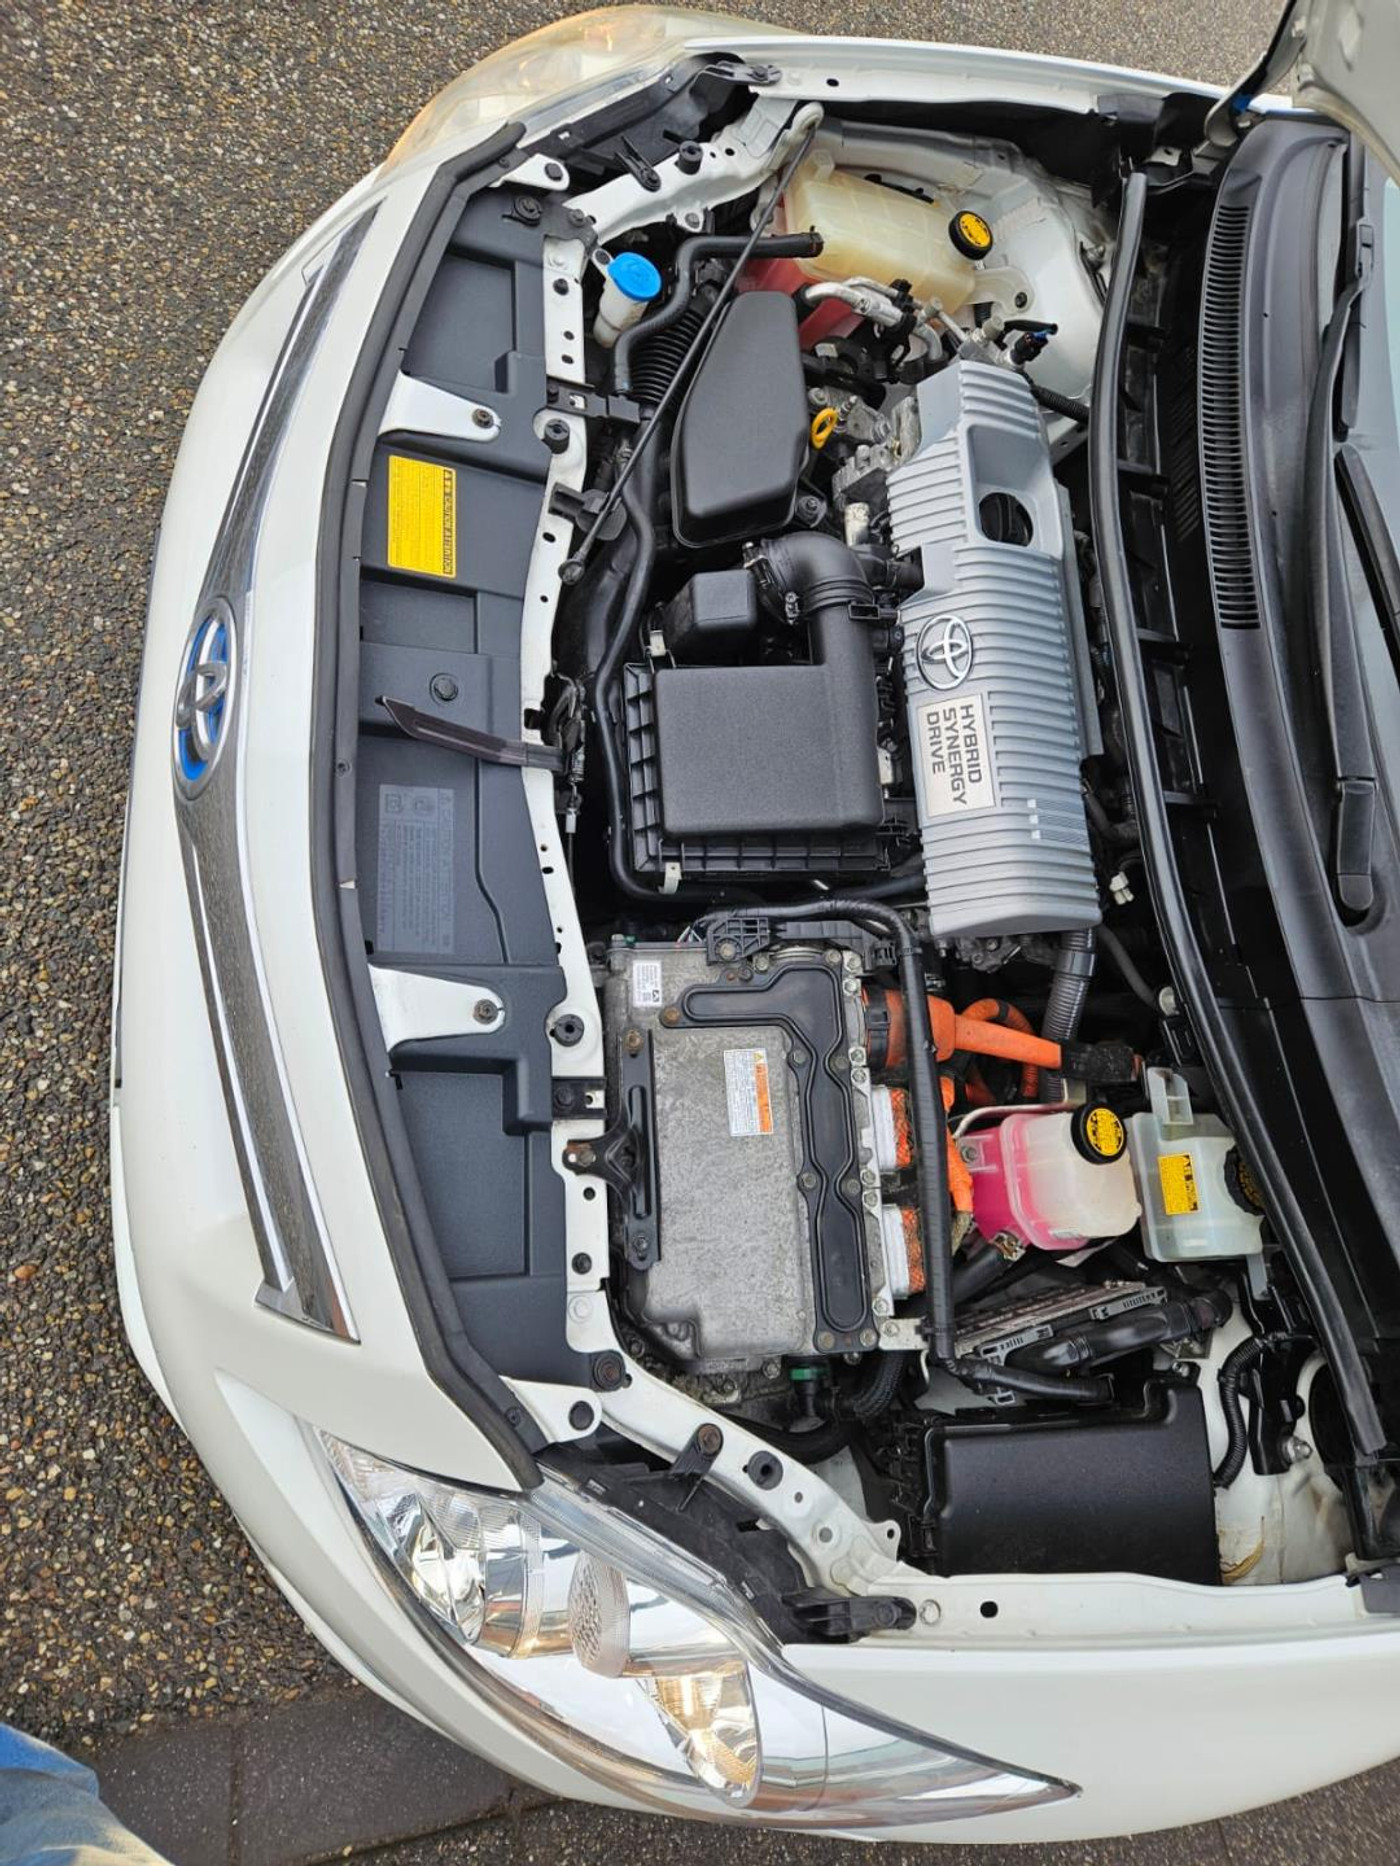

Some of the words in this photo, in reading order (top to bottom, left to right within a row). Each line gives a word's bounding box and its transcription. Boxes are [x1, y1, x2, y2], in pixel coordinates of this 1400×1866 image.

[926, 711, 945, 775] DRIVE
[943, 708, 967, 805] SYNERGY
[960, 705, 982, 784] HYBRID
